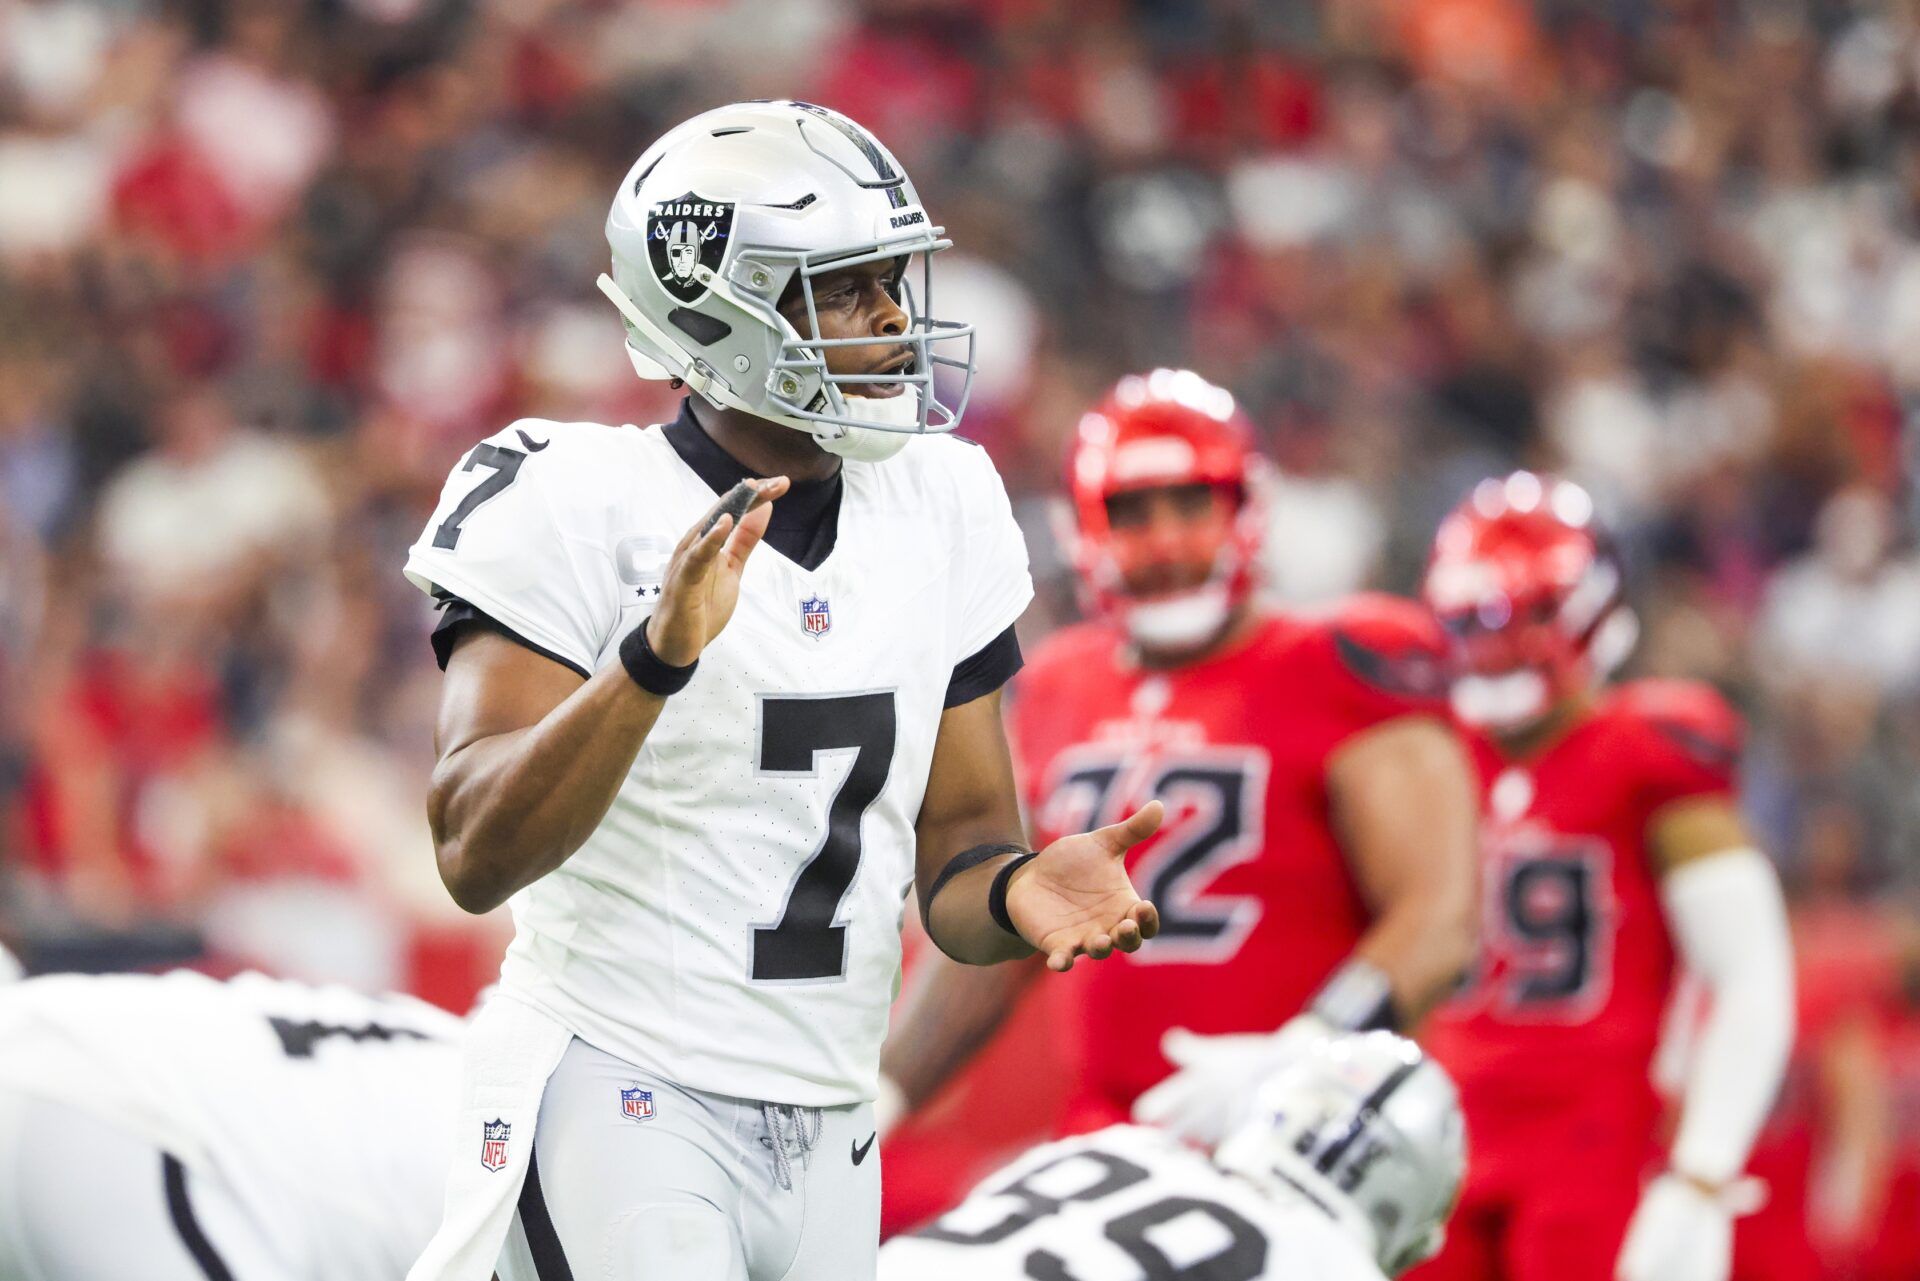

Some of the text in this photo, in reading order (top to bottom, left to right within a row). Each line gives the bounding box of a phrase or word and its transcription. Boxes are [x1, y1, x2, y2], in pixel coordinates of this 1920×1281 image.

[655, 203, 725, 217] RAIDERS
[889, 211, 925, 229] RAIDERS
[431, 442, 528, 552] 7
[806, 613, 829, 632] NFL
[749, 688, 898, 983] 7
[624, 1100, 651, 1117] NFL
[483, 1140, 508, 1167] NFL
